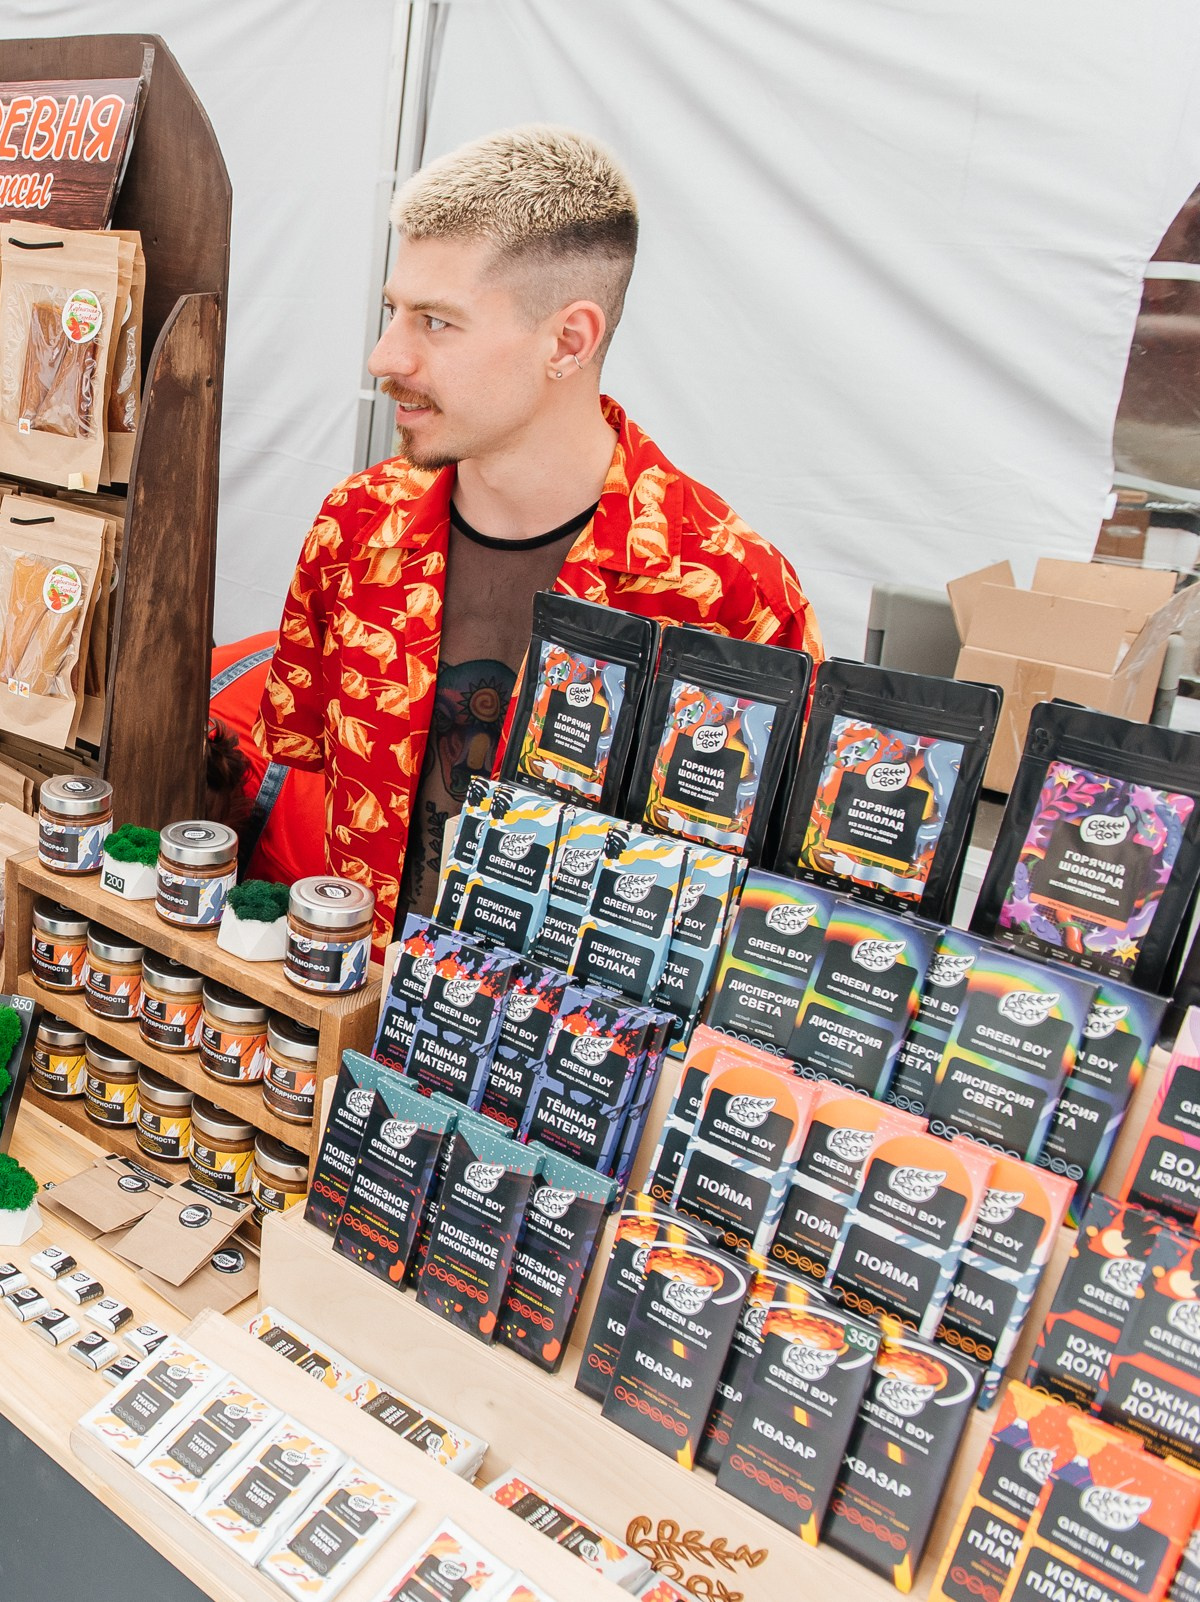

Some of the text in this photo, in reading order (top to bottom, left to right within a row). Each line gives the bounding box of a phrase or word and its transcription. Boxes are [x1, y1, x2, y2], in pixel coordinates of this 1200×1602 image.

[570, 686, 591, 696] GREEN
[554, 721, 590, 742] ШОКОЛАД
[557, 712, 592, 732] ГОРЯЧИЙ
[697, 730, 724, 740] GREEN
[701, 740, 721, 749] BOY
[678, 769, 724, 790] ШОКОЛАД
[682, 759, 725, 779] ГОРЯЧИЙ
[873, 767, 906, 778] GREEN
[880, 776, 902, 786] BOY
[848, 809, 904, 832] ШОКОЛАД
[853, 798, 906, 820] ГОРЯЧИЙ
[850, 828, 864, 836] FINO
[873, 833, 893, 845] AROMA
[1088, 819, 1125, 831] GREEN
[1095, 830, 1121, 841] BOY
[489, 854, 536, 877] GREEN BOY
[1064, 850, 1125, 876] ГОРЯЧИЙ
[106, 874, 123, 889] 200
[1059, 861, 1124, 889] ШОКОЛАД
[477, 896, 522, 919] ПЕРИСТЫЕ
[603, 896, 658, 921] GREEN BOY
[474, 908, 516, 931] ОБЛАКА
[544, 917, 578, 934] ЕРИСТЫ
[684, 917, 706, 931] BOY
[590, 941, 642, 966] ПЕРИСТЫЕ
[748, 938, 812, 963] GREEN BOY
[588, 952, 636, 979] ОБЛАКА
[729, 979, 799, 1009] ДИСПЕРСИЯ
[832, 972, 898, 1003] GREEN BOY
[13, 998, 32, 1010] 350
[434, 1001, 482, 1027] GREEN BOY
[738, 995, 782, 1018] СВЕТА
[385, 1026, 412, 1046] МАТЕ
[519, 1028, 538, 1043] BOY
[809, 1014, 883, 1050] ДИСПЕРСИЯ
[976, 1024, 1052, 1060] GREEN BOY
[422, 1038, 467, 1067] ТЁМНАЯ
[819, 1031, 864, 1058] СВЕТА
[415, 1050, 468, 1082] МАТЕРИЯ
[491, 1060, 523, 1083] МНАЯ
[560, 1058, 613, 1088] GREEN BOY
[1088, 1057, 1119, 1073] BOY
[951, 1070, 1035, 1110] ДИСПЕРСИЯ
[546, 1096, 597, 1131] ТЁМНАЯ
[962, 1088, 1014, 1117] СВЕТА
[338, 1107, 362, 1126] GREEN
[537, 1109, 597, 1146] МАТЕРИЯ
[713, 1118, 776, 1152] GREEN BOY
[325, 1142, 356, 1168] ПОЛЕЗ
[371, 1138, 417, 1169] GREEN BOY
[813, 1152, 852, 1174] GREEN
[353, 1185, 407, 1222] ИСКОПАЕМОЕ
[356, 1172, 410, 1212] ПОЛЕЗНОЕ
[454, 1182, 505, 1214] GREEN BOY
[697, 1173, 753, 1211] ПОЙМА
[874, 1190, 946, 1229] GREEN BOY
[553, 1221, 575, 1240] BOY
[795, 1209, 841, 1240] ПОЙМ
[440, 1220, 500, 1260] ПОЛЕЗНОЕ
[994, 1232, 1024, 1252] BOY
[437, 1233, 496, 1271] ИСКОПАЕМОЕ
[854, 1249, 920, 1292] ПОЙМА
[650, 1300, 712, 1340] GREEN BOY
[846, 1328, 878, 1350] 350
[1150, 1326, 1200, 1358] GREEN
[634, 1350, 693, 1390] КВАЗАР
[769, 1363, 838, 1408] GREEN BOY
[131, 1400, 151, 1418] ПОЛЕ
[135, 1393, 158, 1414] ТИХОЕ
[752, 1416, 817, 1460] КВАЗАР
[906, 1421, 934, 1444] BOY
[188, 1442, 208, 1460] ПОЛЕ
[192, 1434, 215, 1455] ТИХОЕ
[246, 1490, 267, 1509] ПОЛЕ
[250, 1482, 274, 1504] ТИХОЕ
[309, 1535, 332, 1556] ПОЛЕ
[314, 1526, 340, 1552] ТИХОЕ
[1057, 1516, 1146, 1570] GREEN BOY
